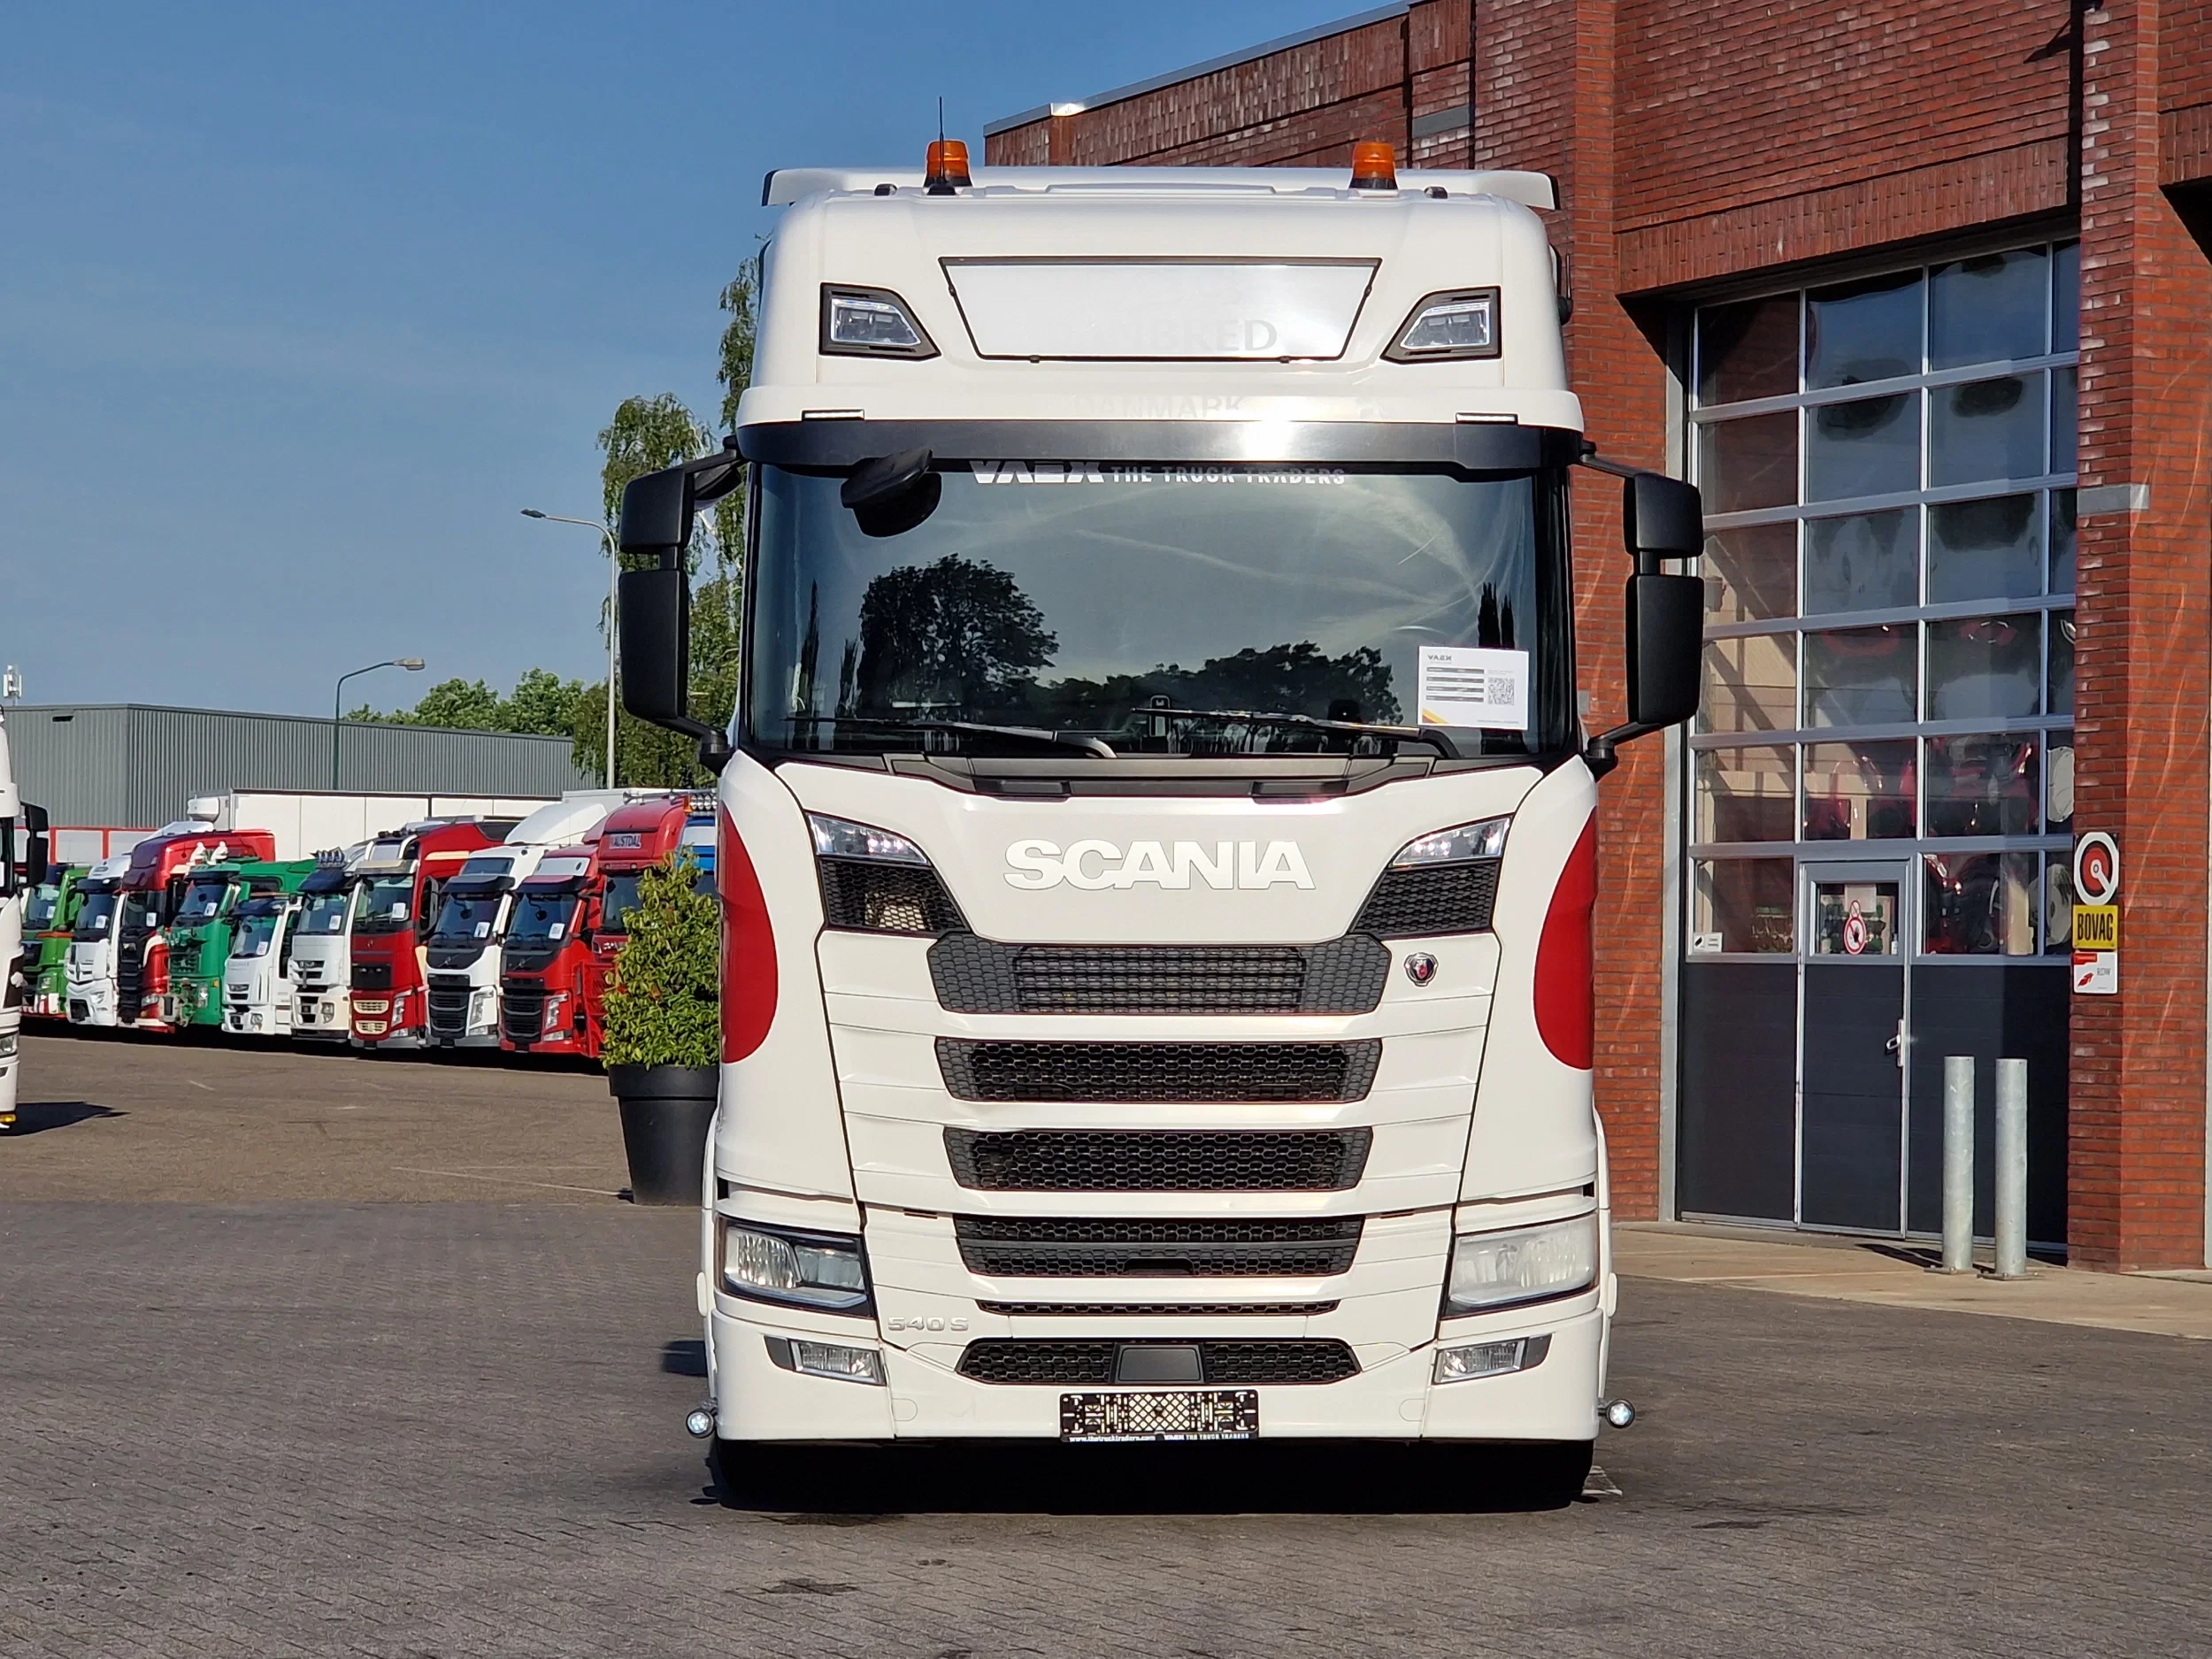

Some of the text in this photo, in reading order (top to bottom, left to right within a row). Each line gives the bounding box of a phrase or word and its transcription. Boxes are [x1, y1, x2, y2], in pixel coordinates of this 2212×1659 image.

[970, 460, 1345, 485] VAEX THE TRUCK TRADERS
[1003, 839, 1316, 890] SCANIA
[2077, 912, 2114, 941] BOVAG
[887, 1316, 969, 1332] 540 S
